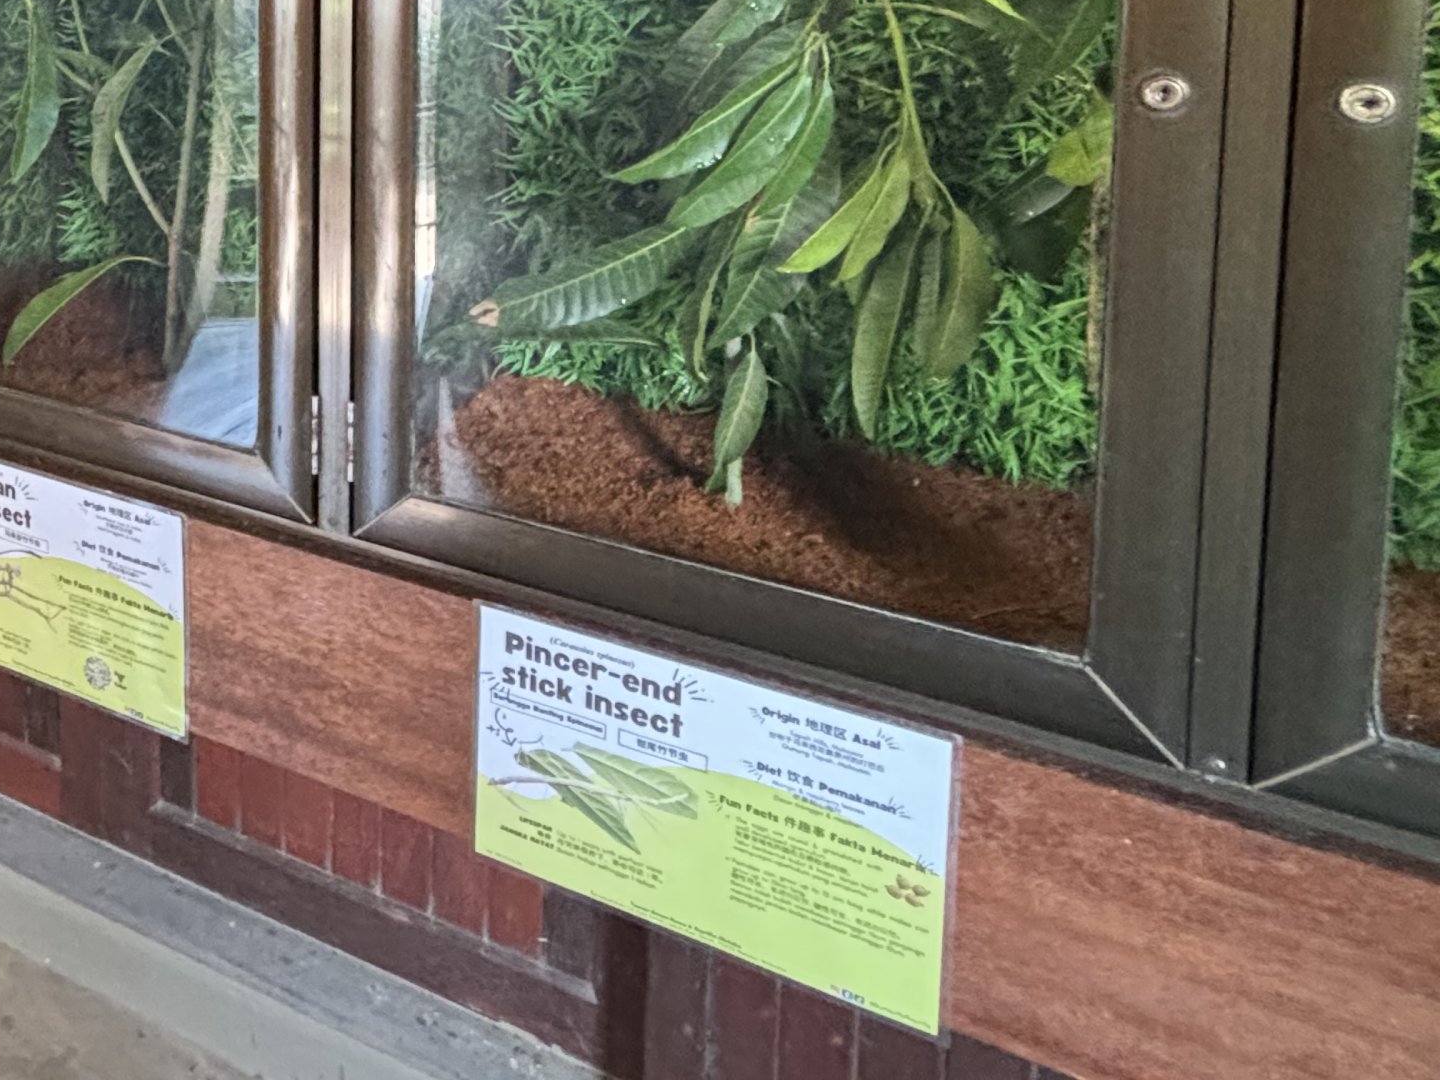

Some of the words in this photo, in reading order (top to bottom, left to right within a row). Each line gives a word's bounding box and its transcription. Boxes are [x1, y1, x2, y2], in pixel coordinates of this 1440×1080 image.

[505, 631, 682, 706] Pincer-end
[502, 666, 573, 704] stick
[585, 685, 683, 738] insect
[761, 706, 801, 725] Origin
[805, 717, 848, 741] 地理区
[852, 733, 881, 750] Asal
[756, 761, 782, 778] Diet
[787, 769, 814, 789] 饮食
[818, 781, 897, 815] Pemakanan
[719, 794, 742, 811] Fun
[745, 803, 779, 823] Facts
[829, 832, 866, 853] Fakta
